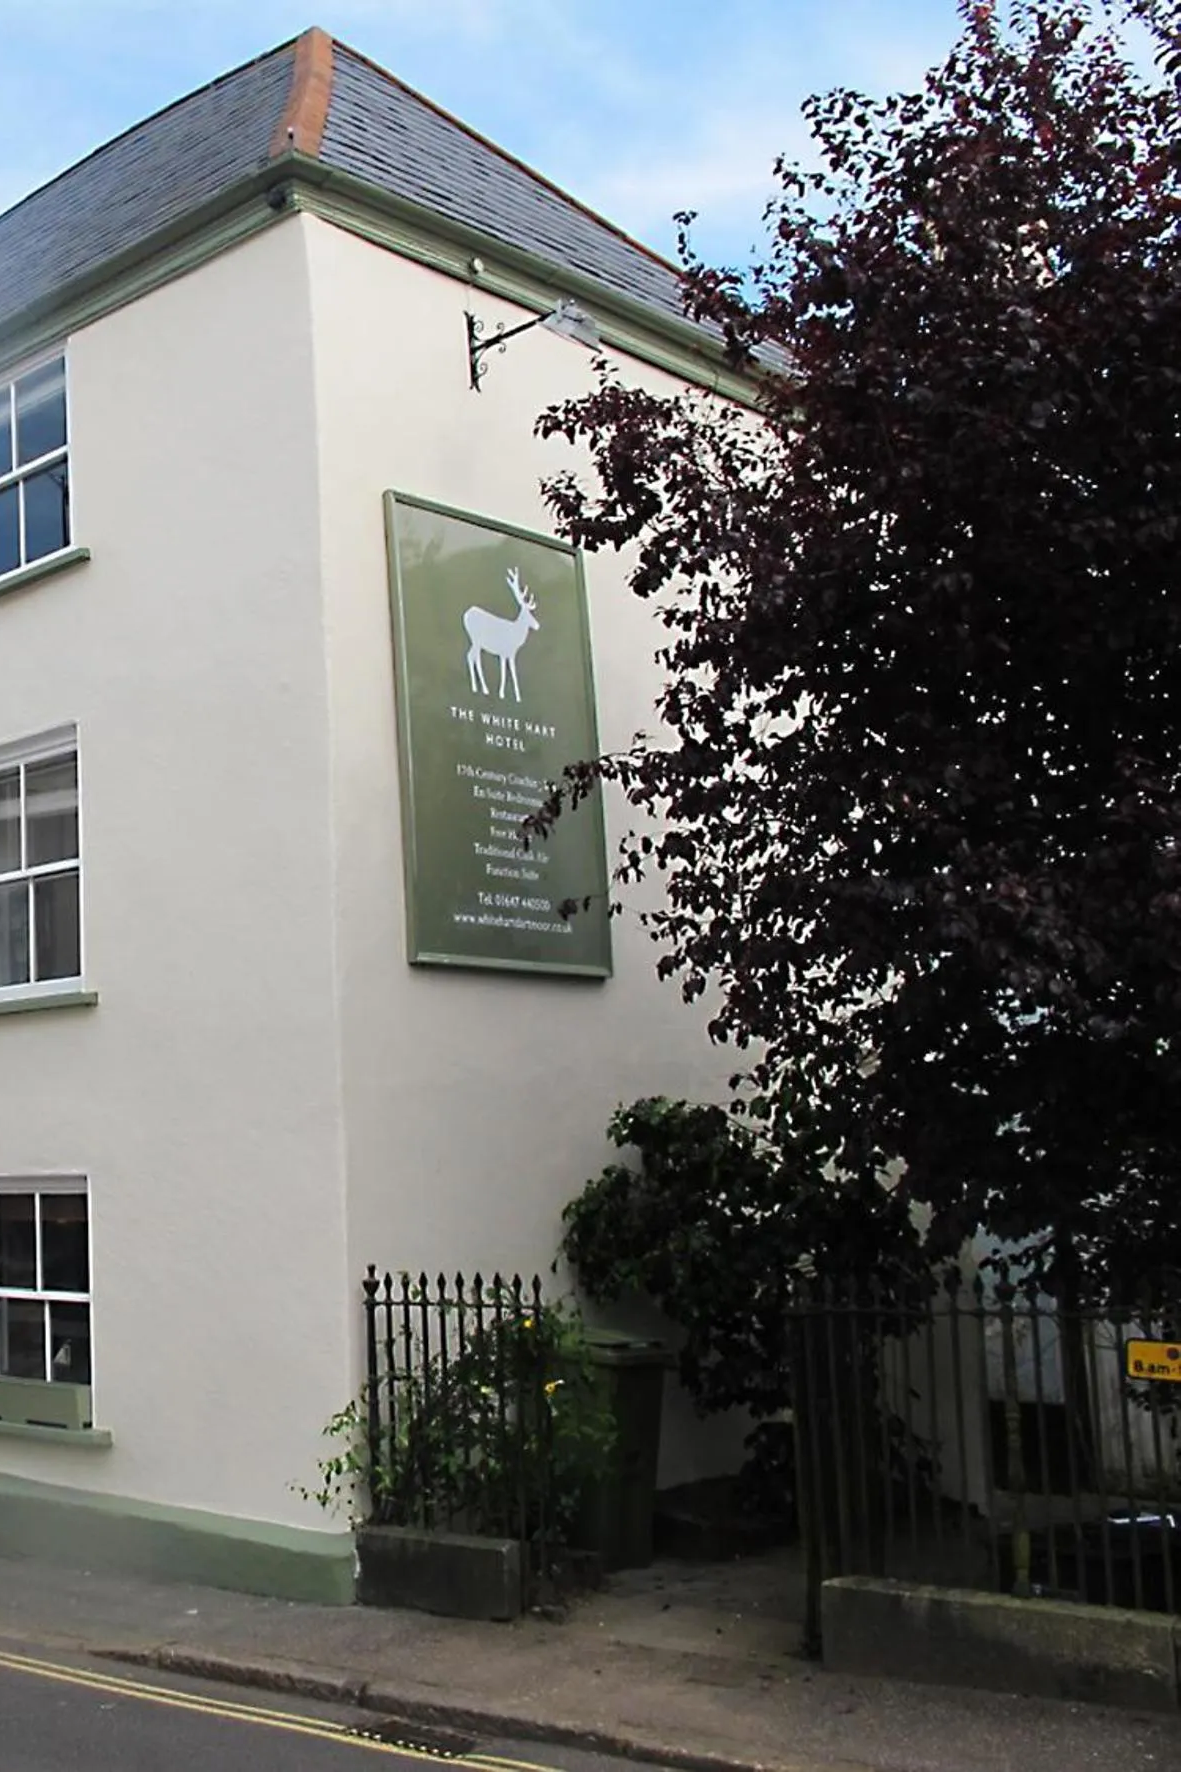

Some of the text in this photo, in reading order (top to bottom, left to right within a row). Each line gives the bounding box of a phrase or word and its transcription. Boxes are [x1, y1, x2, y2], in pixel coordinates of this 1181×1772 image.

[450, 706, 556, 739] THE WHITE HART
[485, 733, 525, 753] HOTEL
